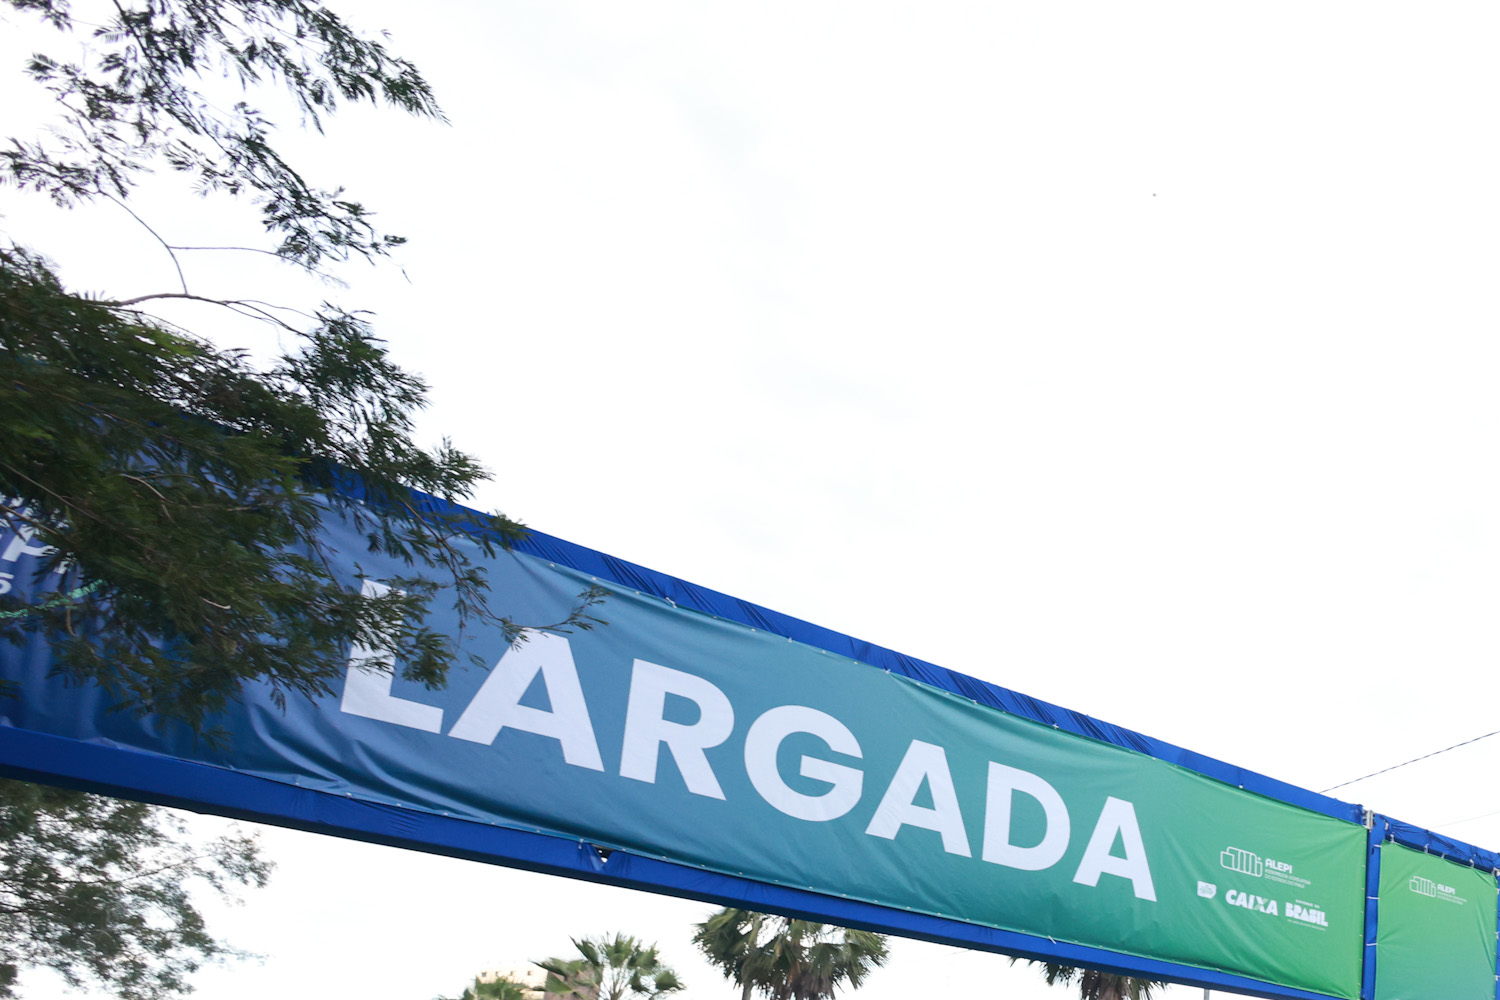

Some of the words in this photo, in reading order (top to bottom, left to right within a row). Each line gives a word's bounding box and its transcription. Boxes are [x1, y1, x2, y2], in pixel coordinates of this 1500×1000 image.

[340, 579, 1157, 902] LARGADA
[1265, 858, 1293, 874] ALEPI
[1225, 889, 1278, 916] CAIXA
[1285, 902, 1328, 927] BRASIL
